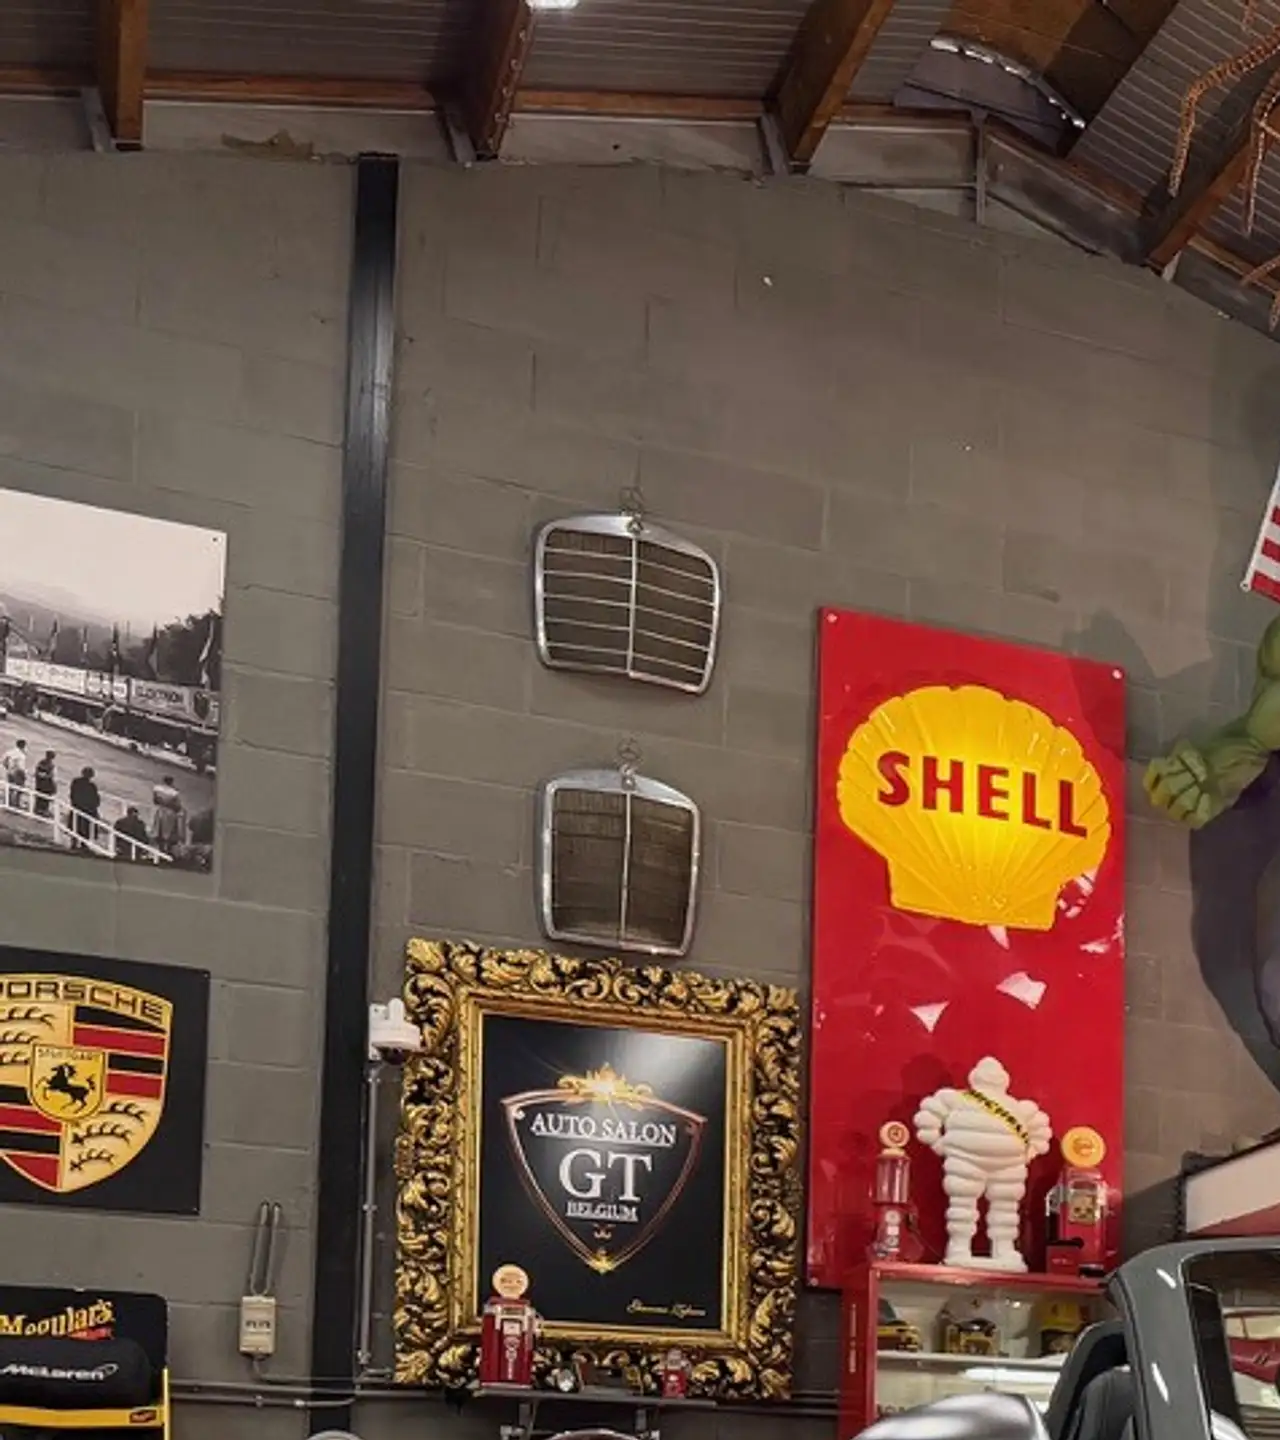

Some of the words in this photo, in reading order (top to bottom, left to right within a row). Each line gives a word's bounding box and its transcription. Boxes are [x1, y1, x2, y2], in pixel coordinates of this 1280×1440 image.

[877, 750, 1087, 839] SHELL
[0, 981, 163, 1016] ORSCHE
[530, 1112, 596, 1138] AUTO
[602, 1118, 677, 1144] SALON
[559, 1148, 652, 1202] GT
[566, 1201, 639, 1220] BELGIUM
